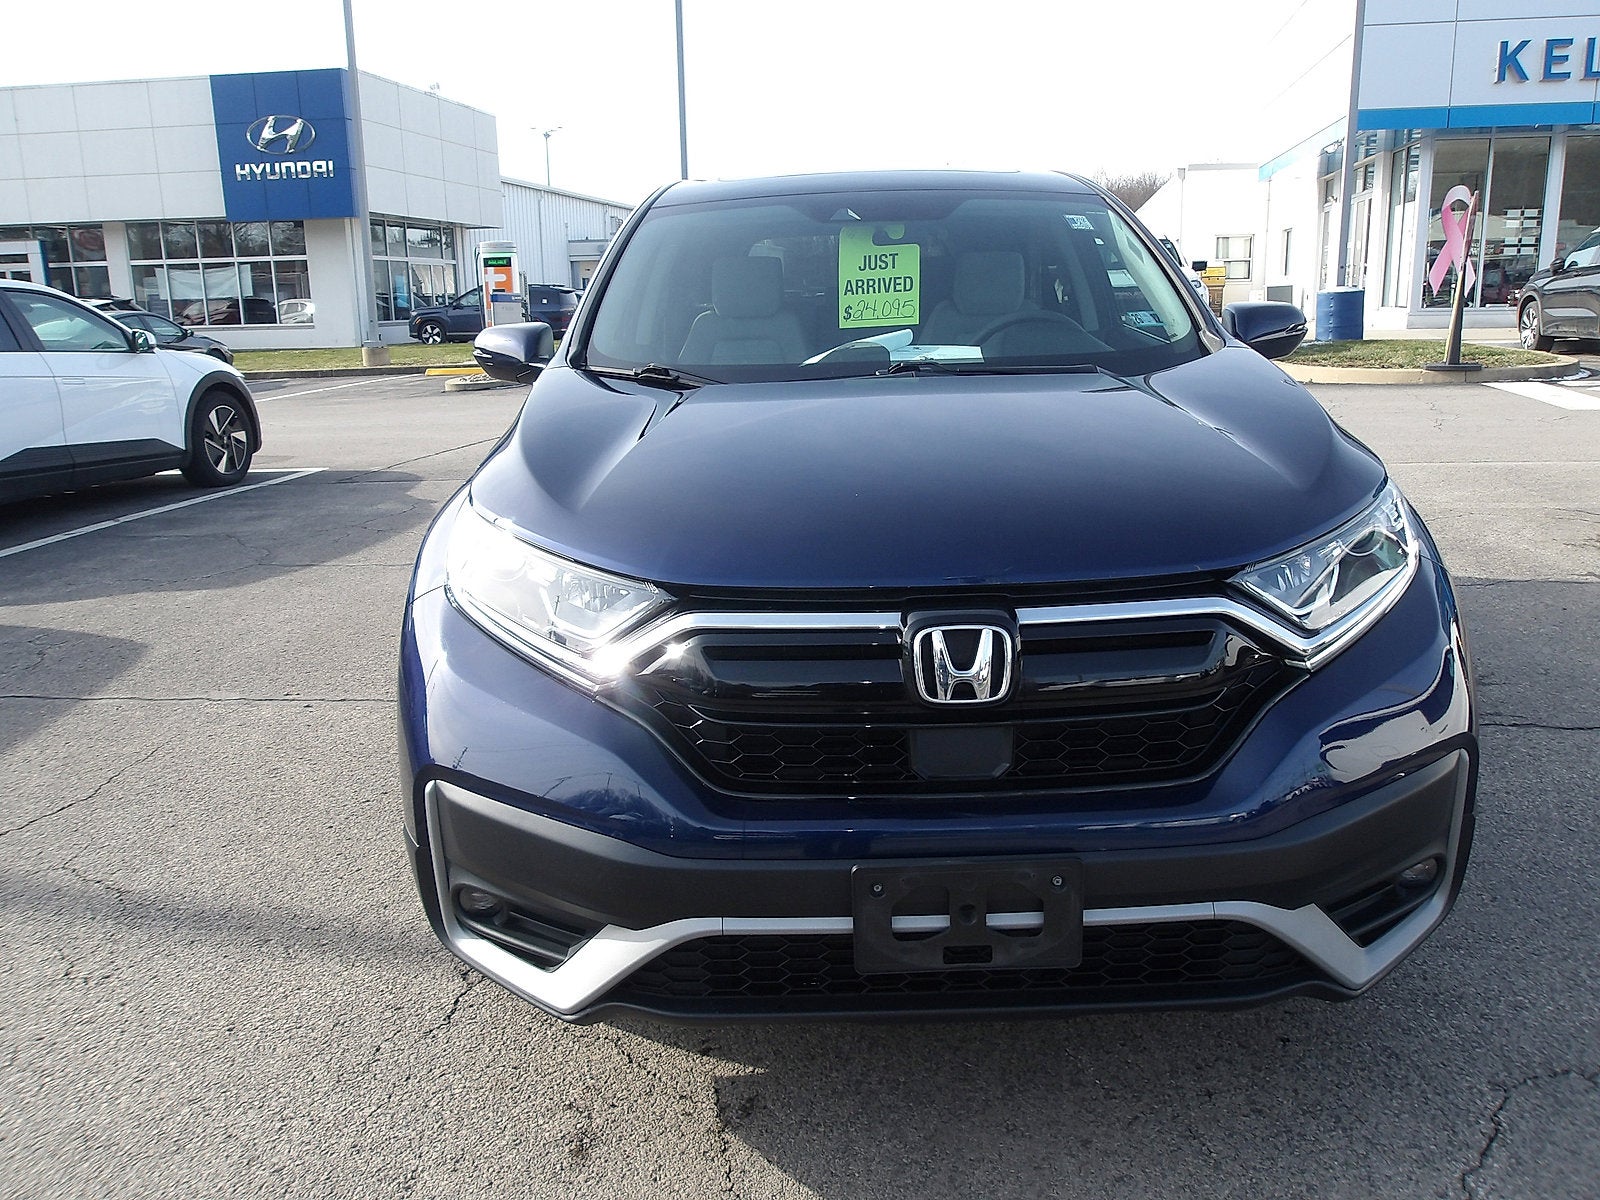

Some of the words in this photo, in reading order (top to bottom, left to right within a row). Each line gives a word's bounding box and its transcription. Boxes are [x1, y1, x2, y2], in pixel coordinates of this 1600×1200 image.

[1496, 36, 1600, 82] KEL
[235, 160, 334, 181] HYUNDAI
[858, 252, 899, 272] JUST
[843, 275, 914, 296] ARRIVED
